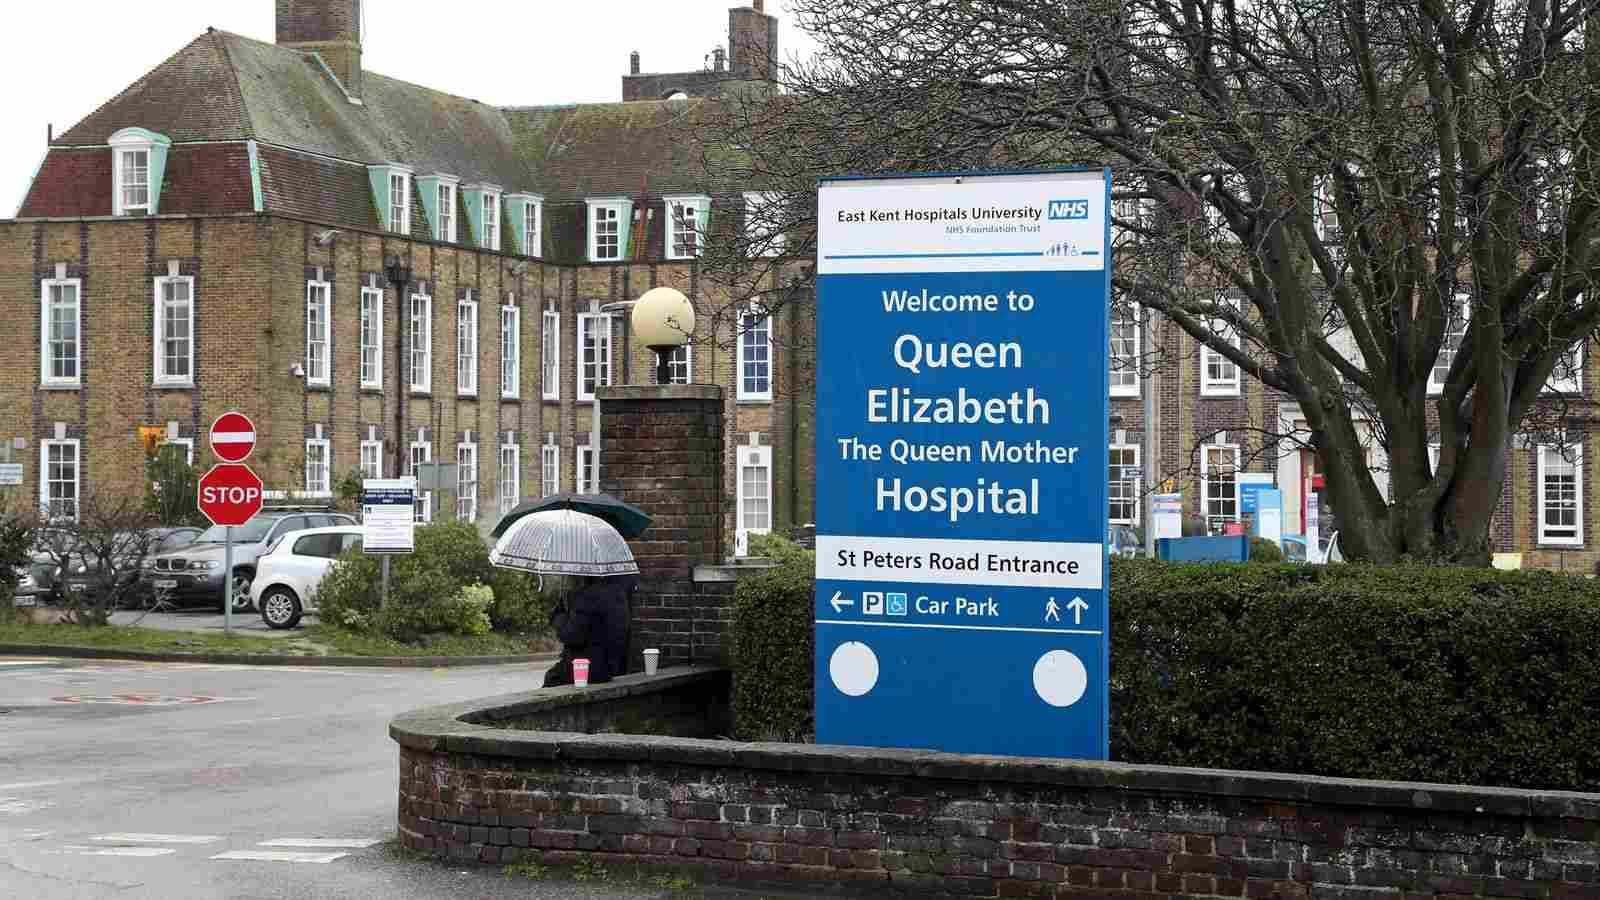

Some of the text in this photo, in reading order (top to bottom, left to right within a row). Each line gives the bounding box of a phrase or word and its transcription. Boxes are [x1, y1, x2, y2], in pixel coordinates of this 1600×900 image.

[837, 201, 1087, 224] East Kent Hospitals University NHS
[945, 224, 1041, 234] NHS Foundation Trust
[882, 289, 1034, 312] Welcome to
[893, 334, 1022, 374] Queen
[867, 387, 1050, 424] Elizabeth
[838, 437, 1079, 465] The Queen Mother
[202, 485, 260, 505] STOP
[876, 477, 1040, 522] Hospital
[837, 549, 1079, 574] St Peters Road Entrance
[915, 596, 949, 615] Car
[955, 597, 999, 617] Park
